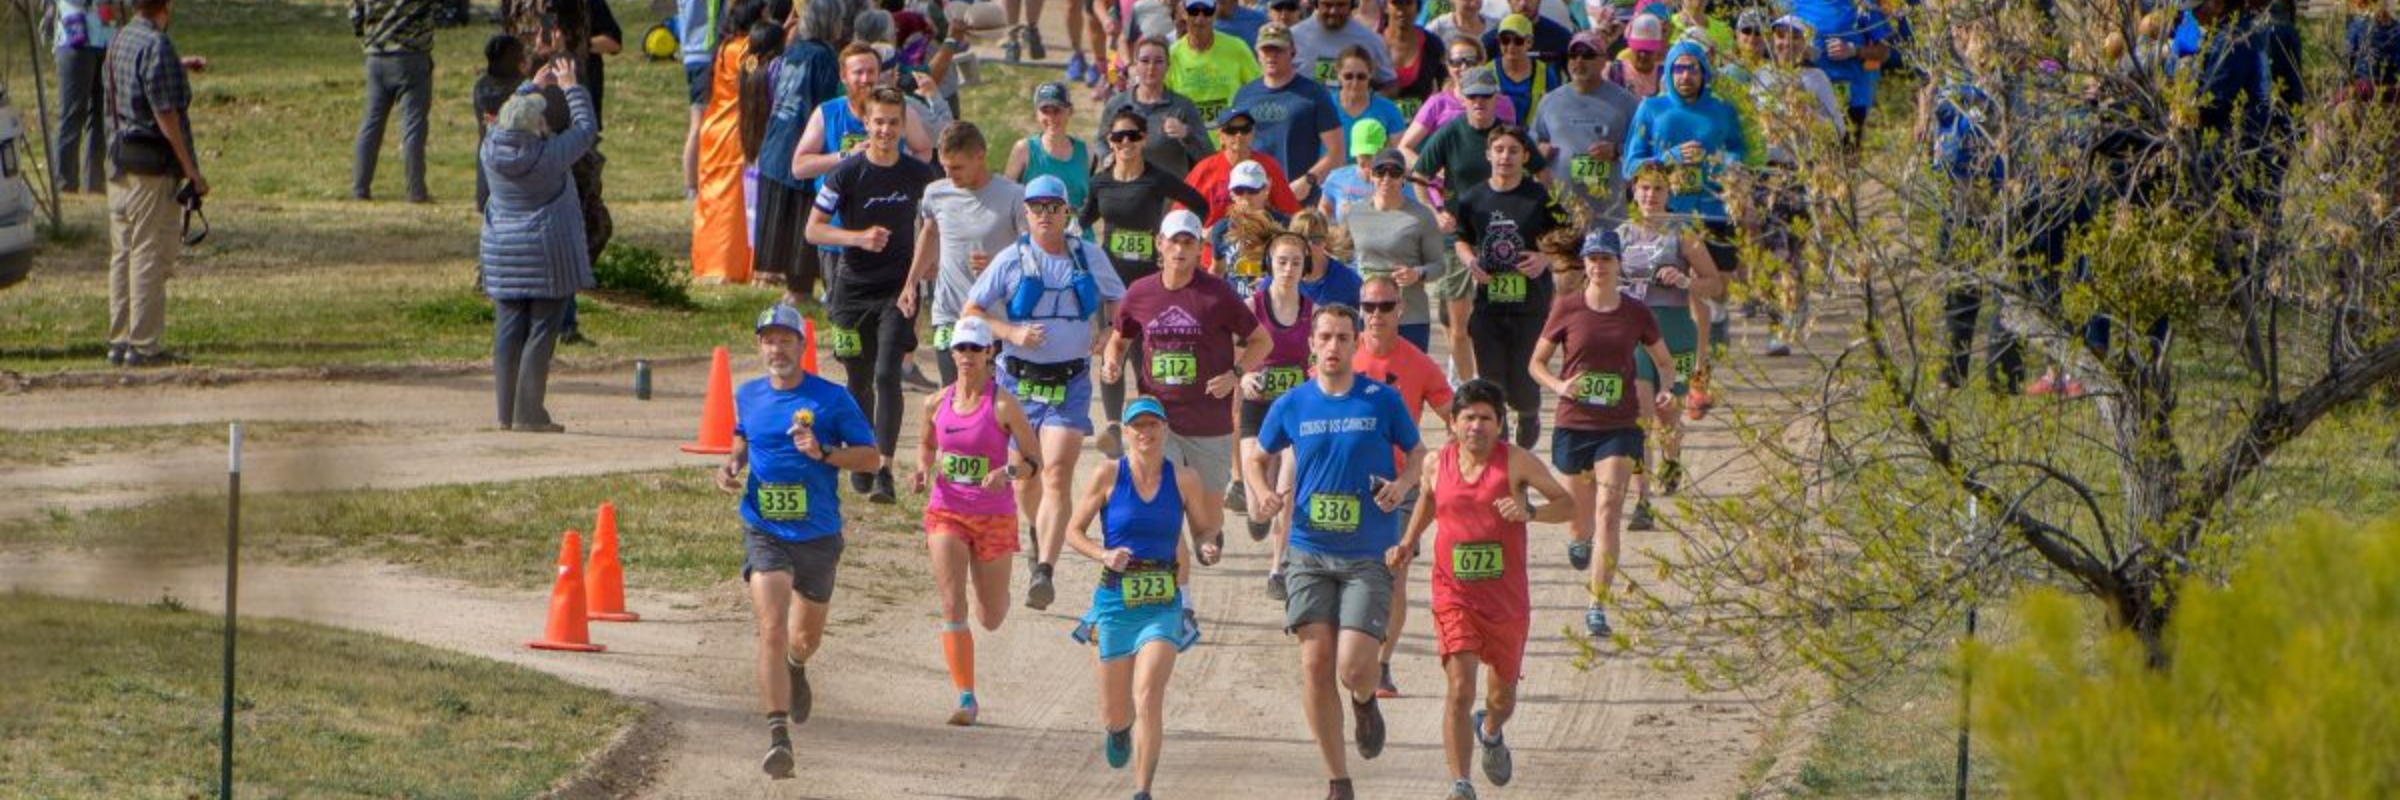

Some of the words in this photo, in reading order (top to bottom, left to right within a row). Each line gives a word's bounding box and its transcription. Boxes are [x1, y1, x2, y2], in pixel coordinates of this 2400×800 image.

[1577, 161, 1605, 177] 270
[1117, 235, 1145, 253] 285
[1491, 277, 1517, 295] 321
[1159, 359, 1188, 377] 312
[1582, 378, 1615, 397] 304
[1299, 420, 1327, 438] COUGS
[1329, 419, 1341, 433] VS
[1342, 416, 1377, 433] CANCER
[948, 455, 980, 476] 309
[765, 491, 799, 511] 335
[1317, 501, 1351, 522] 336
[1461, 551, 1496, 571] 672
[1131, 577, 1166, 599] 323
